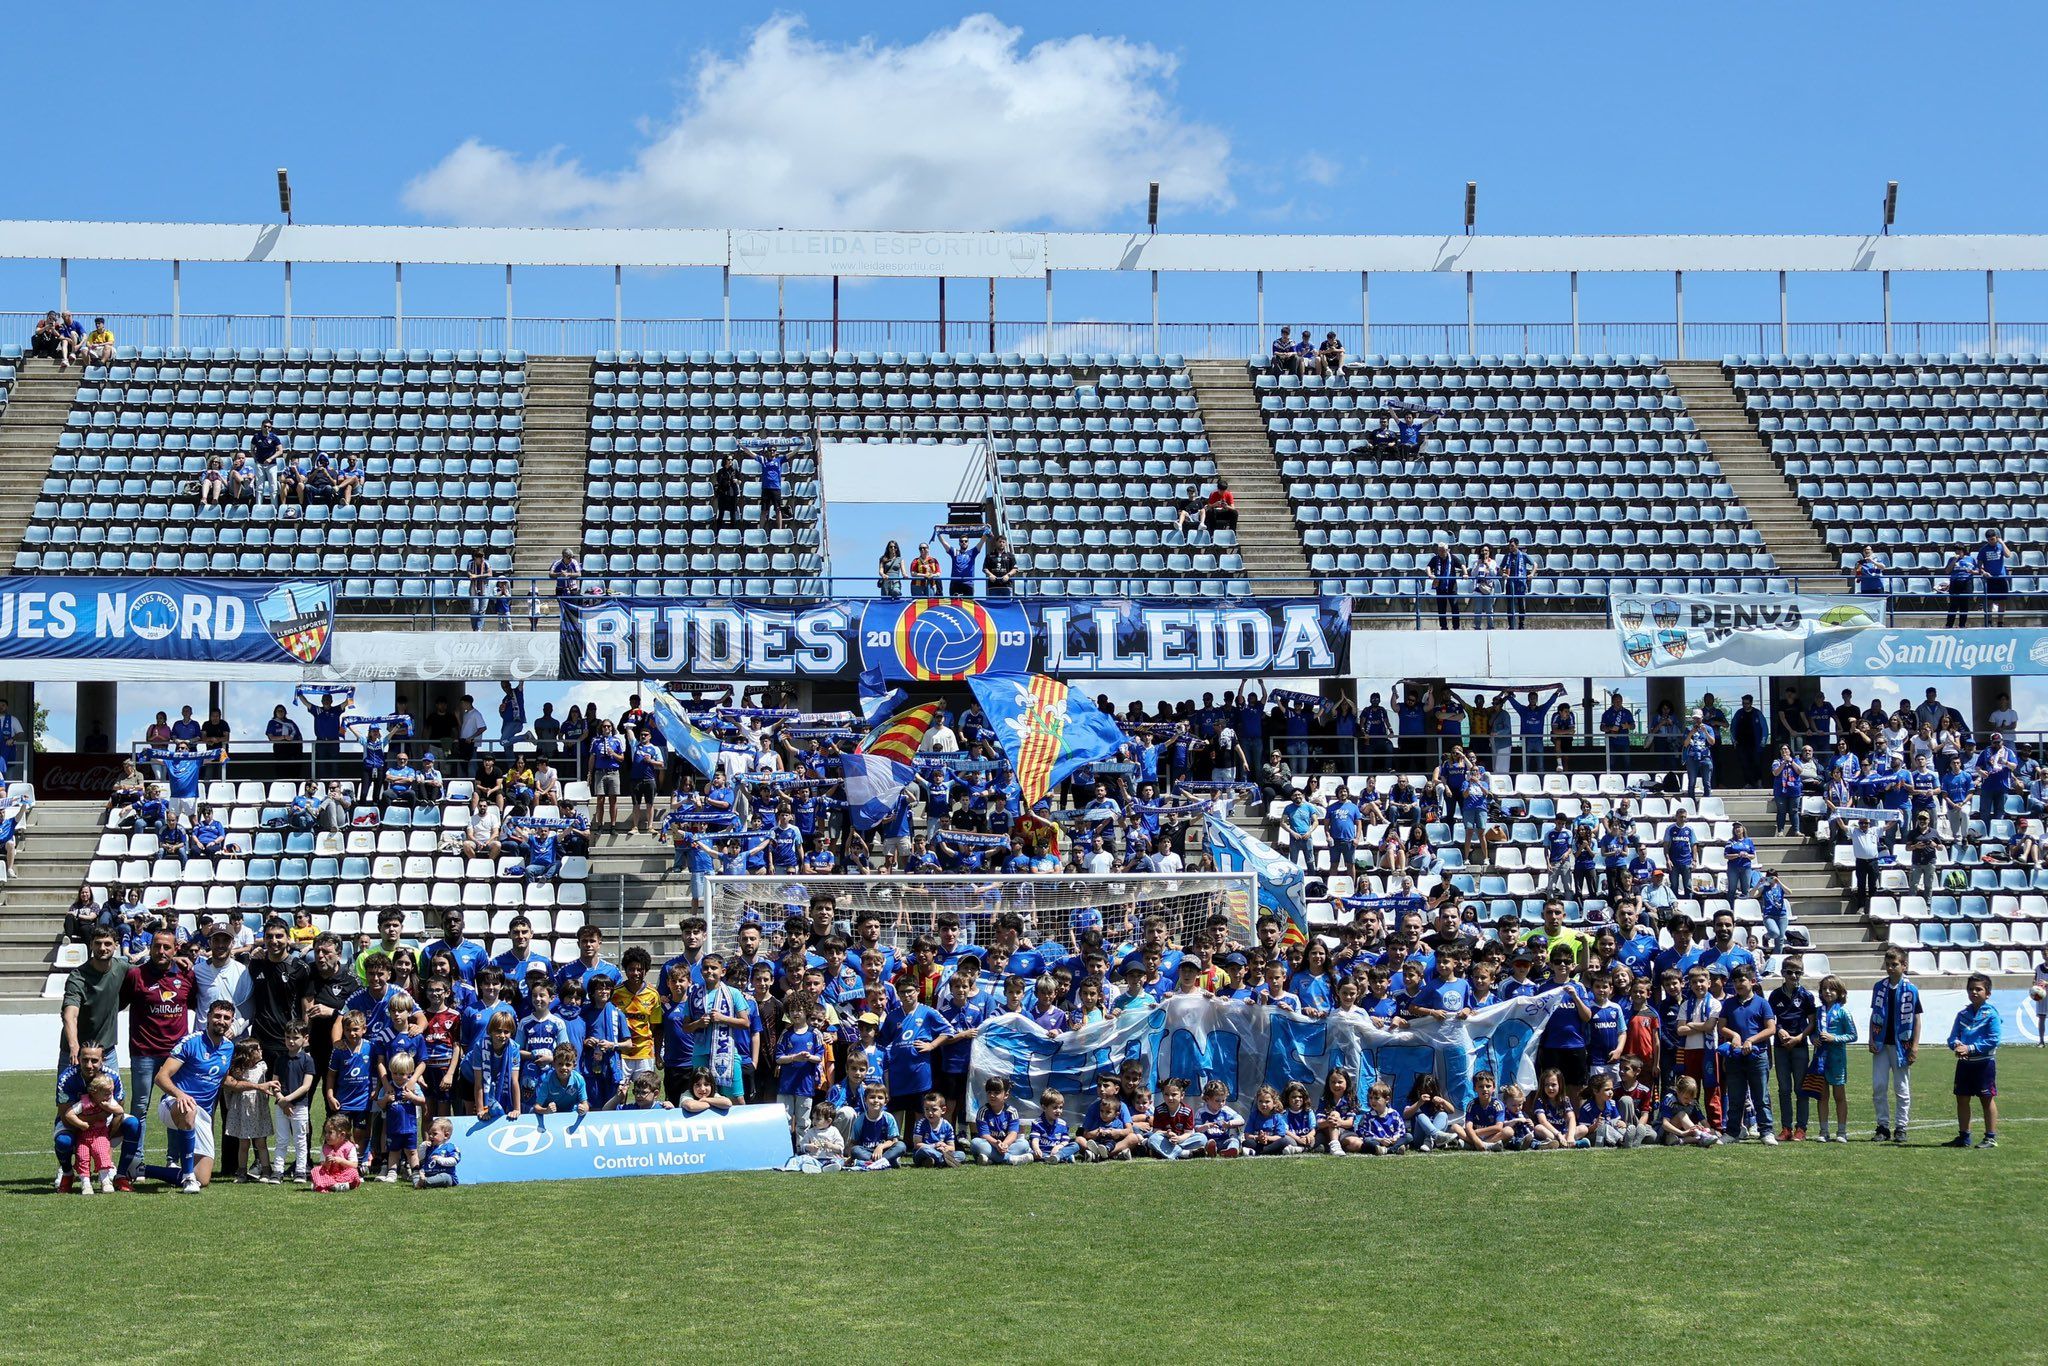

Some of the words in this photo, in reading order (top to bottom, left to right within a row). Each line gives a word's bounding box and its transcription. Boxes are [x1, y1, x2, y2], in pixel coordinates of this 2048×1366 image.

[776, 235, 866, 255] LLEIDA
[874, 236, 1000, 257] ESPORTIU
[830, 260, 945, 272] www.lleidaesportiu.cat
[1690, 603, 1803, 630] PENYA
[276, 626, 299, 638] LLEIDA
[578, 606, 848, 675] RUDES
[866, 632, 891, 647] 20
[999, 631, 1025, 647] 03
[1041, 604, 1336, 673] LLEIDA
[452, 664, 493, 678] HOTELS
[1901, 991, 1914, 1025] COR
[563, 1119, 726, 1148] HYUNDAI
[593, 1154, 654, 1171] Control
[657, 1151, 706, 1167] Motor
